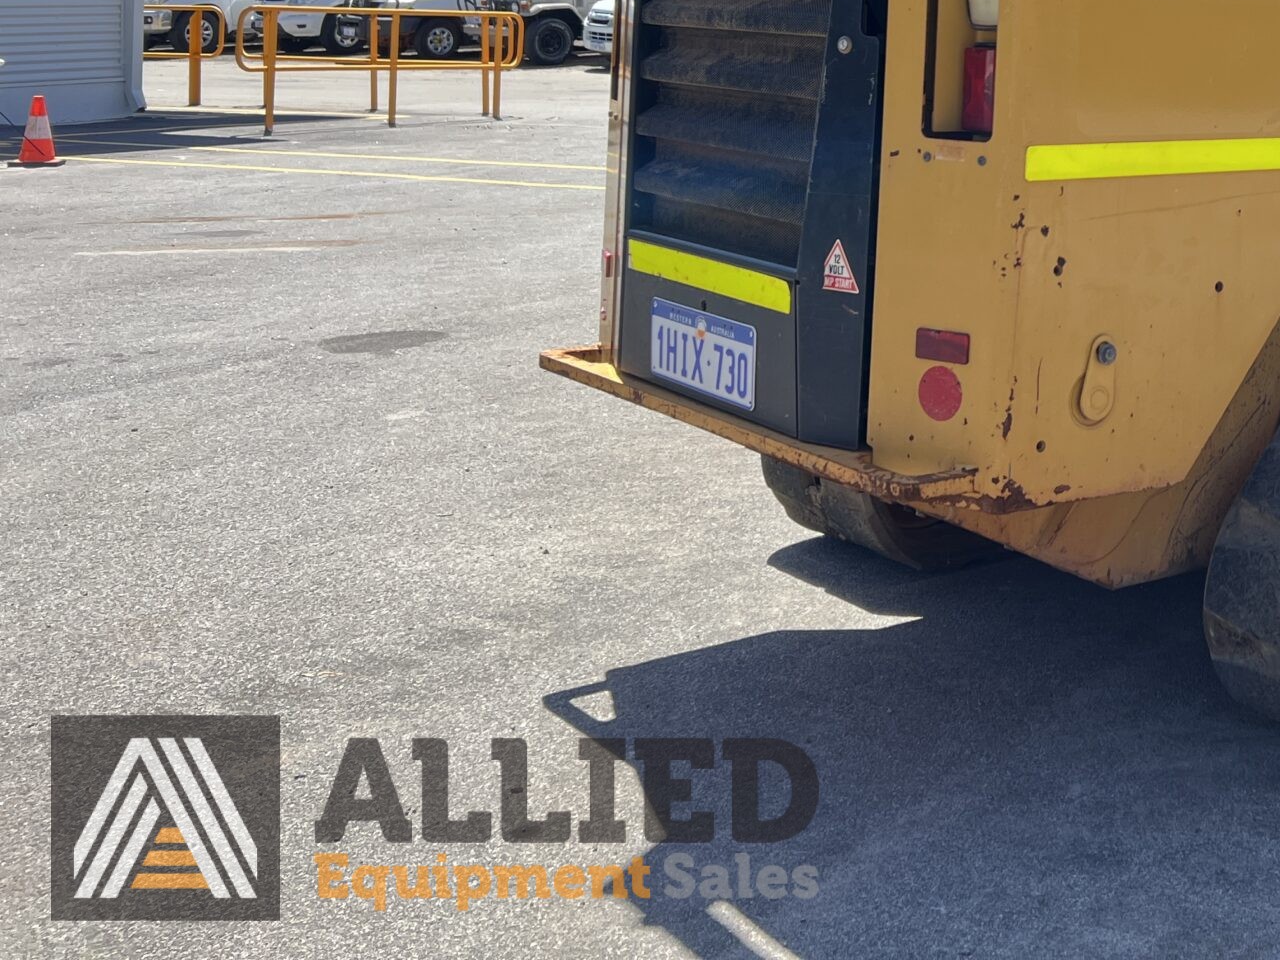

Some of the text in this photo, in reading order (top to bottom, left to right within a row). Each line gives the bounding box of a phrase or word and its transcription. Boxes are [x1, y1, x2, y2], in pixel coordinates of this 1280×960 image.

[834, 254, 841, 264] 12
[829, 264, 845, 275] VOLT
[835, 278, 853, 289] START
[669, 313, 692, 325] WESTERN
